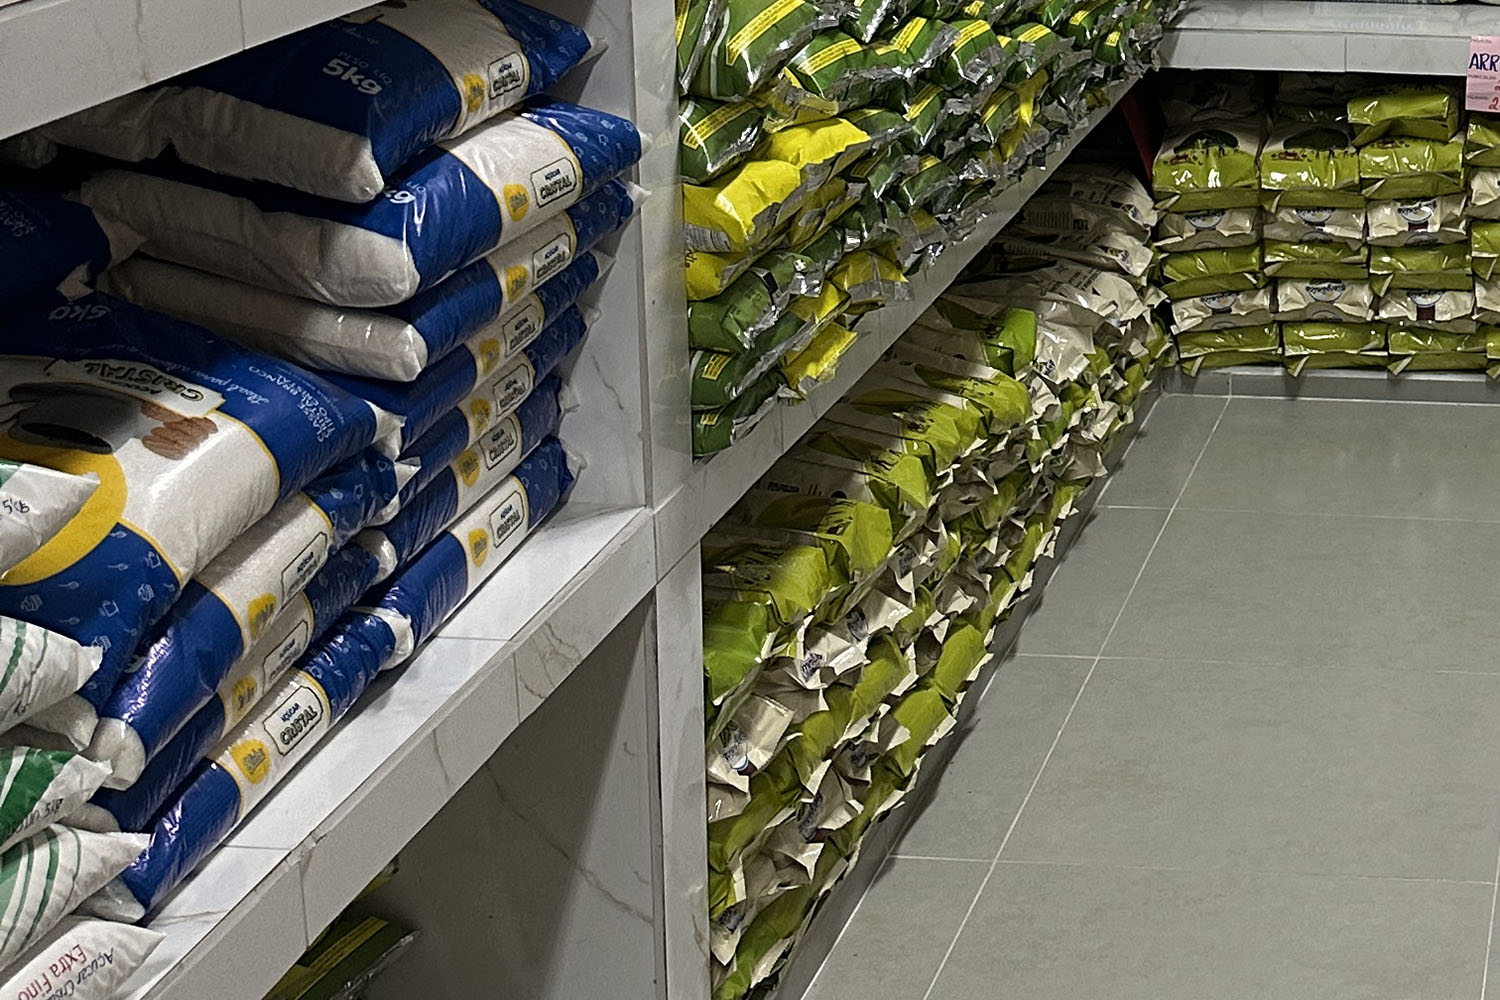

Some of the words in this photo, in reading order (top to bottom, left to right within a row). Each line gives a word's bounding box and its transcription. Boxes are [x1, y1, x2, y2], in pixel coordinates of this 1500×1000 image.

[322, 58, 383, 96] 5kg
[84, 361, 206, 403] CRISTAL
[279, 704, 318, 747] CRISTAL
[49, 943, 88, 979] Extra
[18, 970, 54, 1000] Fino
